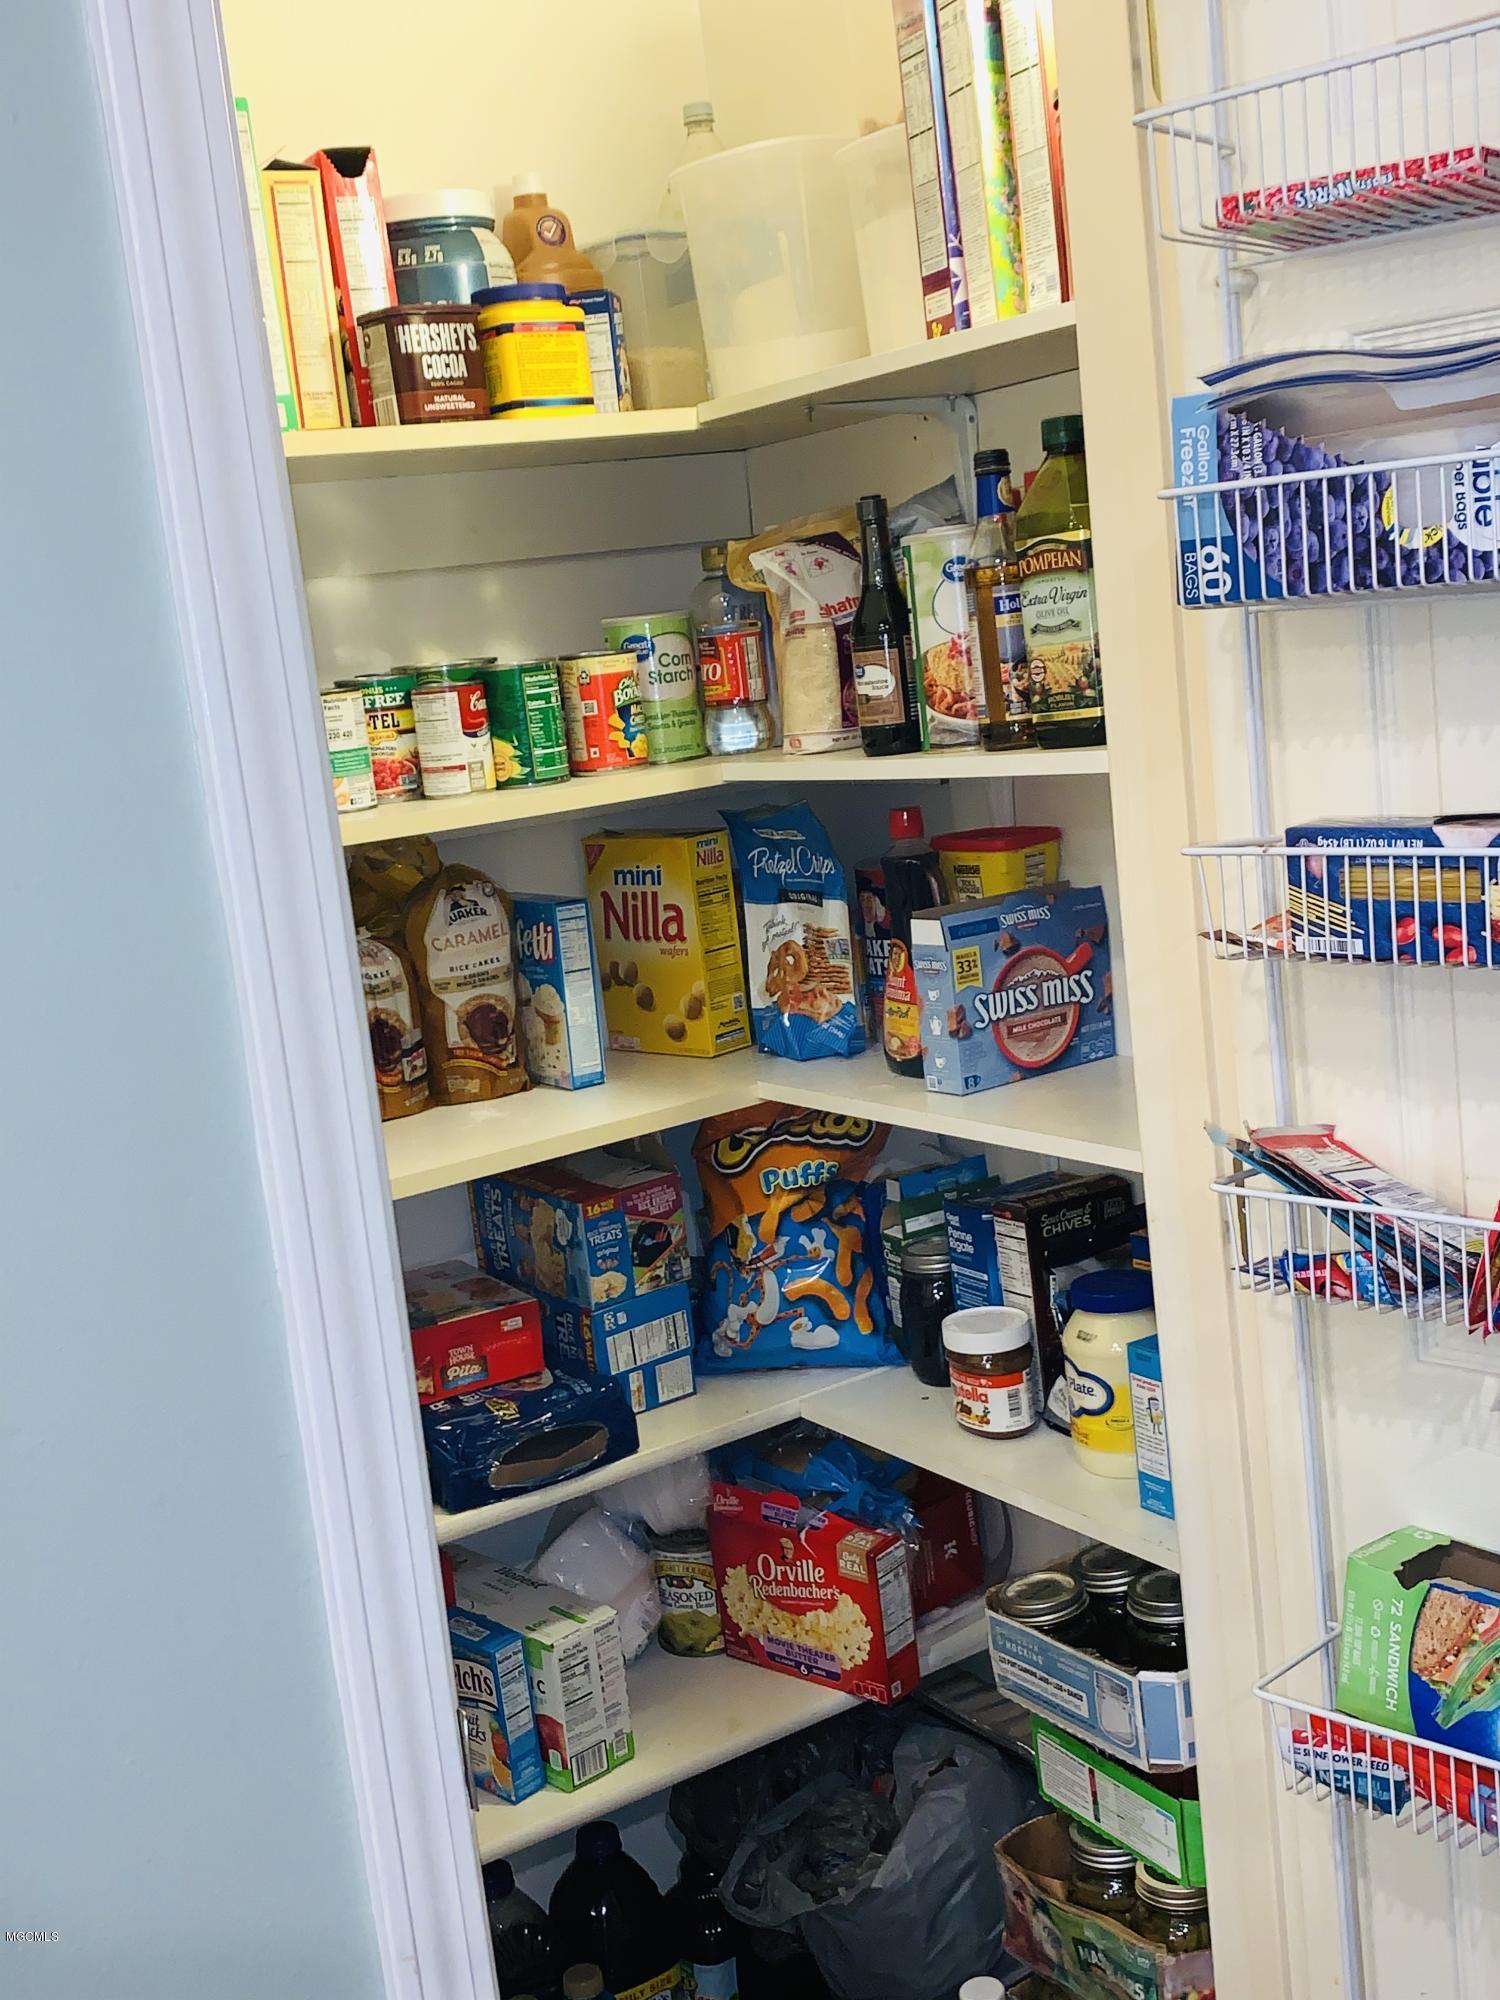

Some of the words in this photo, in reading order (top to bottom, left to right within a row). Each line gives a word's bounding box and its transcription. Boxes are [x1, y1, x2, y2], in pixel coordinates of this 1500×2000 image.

[397, 322, 478, 354] HERSHEY'S
[421, 353, 468, 380] COCOA
[424, 401, 476, 412] UNSWEETENED
[433, 394, 466, 403] NATURAL
[1197, 424, 1210, 484] Gallon
[1252, 431, 1263, 464] GALLON
[1180, 427, 1196, 507] Freezr
[1471, 459, 1492, 527] uble
[1018, 550, 1082, 577] POMPEIAN
[1200, 545, 1233, 598] 60
[1184, 552, 1199, 599] BAGS
[1020, 589, 1048, 609] Extra
[1049, 586, 1088, 606] Virgin
[1035, 606, 1056, 619] OLIVE
[1057, 605, 1070, 617] OIL
[658, 653, 691, 668] Corn
[648, 668, 694, 686] Starch
[360, 687, 384, 695] ONUS
[362, 692, 405, 709] FREE
[369, 712, 400, 731] TEL
[695, 847, 725, 868] Nilla
[747, 847, 798, 887] Pretzel
[796, 846, 836, 884] Crisps
[613, 865, 663, 887] mini
[449, 906, 488, 926] UAKER
[599, 889, 688, 943] Nilla
[1000, 910, 1027, 928] SWISS
[1027, 905, 1051, 922] MISS
[430, 923, 510, 952] CARAMEL
[515, 919, 556, 965] fetti
[658, 945, 689, 959] wafers
[449, 963, 470, 973] RICE
[472, 956, 502, 969] CAKES
[913, 959, 932, 971] SWISS
[931, 959, 948, 972] MISS
[973, 984, 1040, 1029] SWISS
[1041, 970, 1094, 1007] MISS
[1012, 1025, 1027, 1034] MILK
[1027, 1016, 1062, 1031] CHOCOLATE
[967, 1077, 977, 1088] 8
[758, 1159, 840, 1196] Puffs
[586, 1202, 600, 1217] 16
[489, 1187, 512, 1269] TREATS
[947, 1226, 973, 1242] Penne
[1042, 1214, 1092, 1238] CHIVES
[588, 1229, 623, 1247] TREATS
[949, 1237, 975, 1254] Rigate
[596, 1245, 620, 1258] Original
[448, 1343, 475, 1357] TOWN
[449, 1353, 476, 1365] HOUSE
[446, 1363, 482, 1381] Pita
[1068, 1375, 1096, 1397] Plate
[715, 1493, 740, 1506] Orville
[845, 1534, 873, 1548] REAL
[840, 1560, 866, 1575] REAL
[841, 1551, 861, 1564] Only
[757, 1553, 825, 1584] Orville
[752, 1575, 840, 1602] Redenbacher's
[1390, 1598, 1404, 1617] 72
[766, 1635, 795, 1650] MOVIE
[796, 1643, 837, 1663] THEATER
[785, 1649, 819, 1665] BUTTER
[801, 1664, 809, 1676] 6
[1385, 1620, 1401, 1712] SANDWICH
[453, 1663, 494, 1697] lch's
[1303, 1747, 1363, 1768] SUNFOWER
[1366, 1760, 1389, 1772] EED
